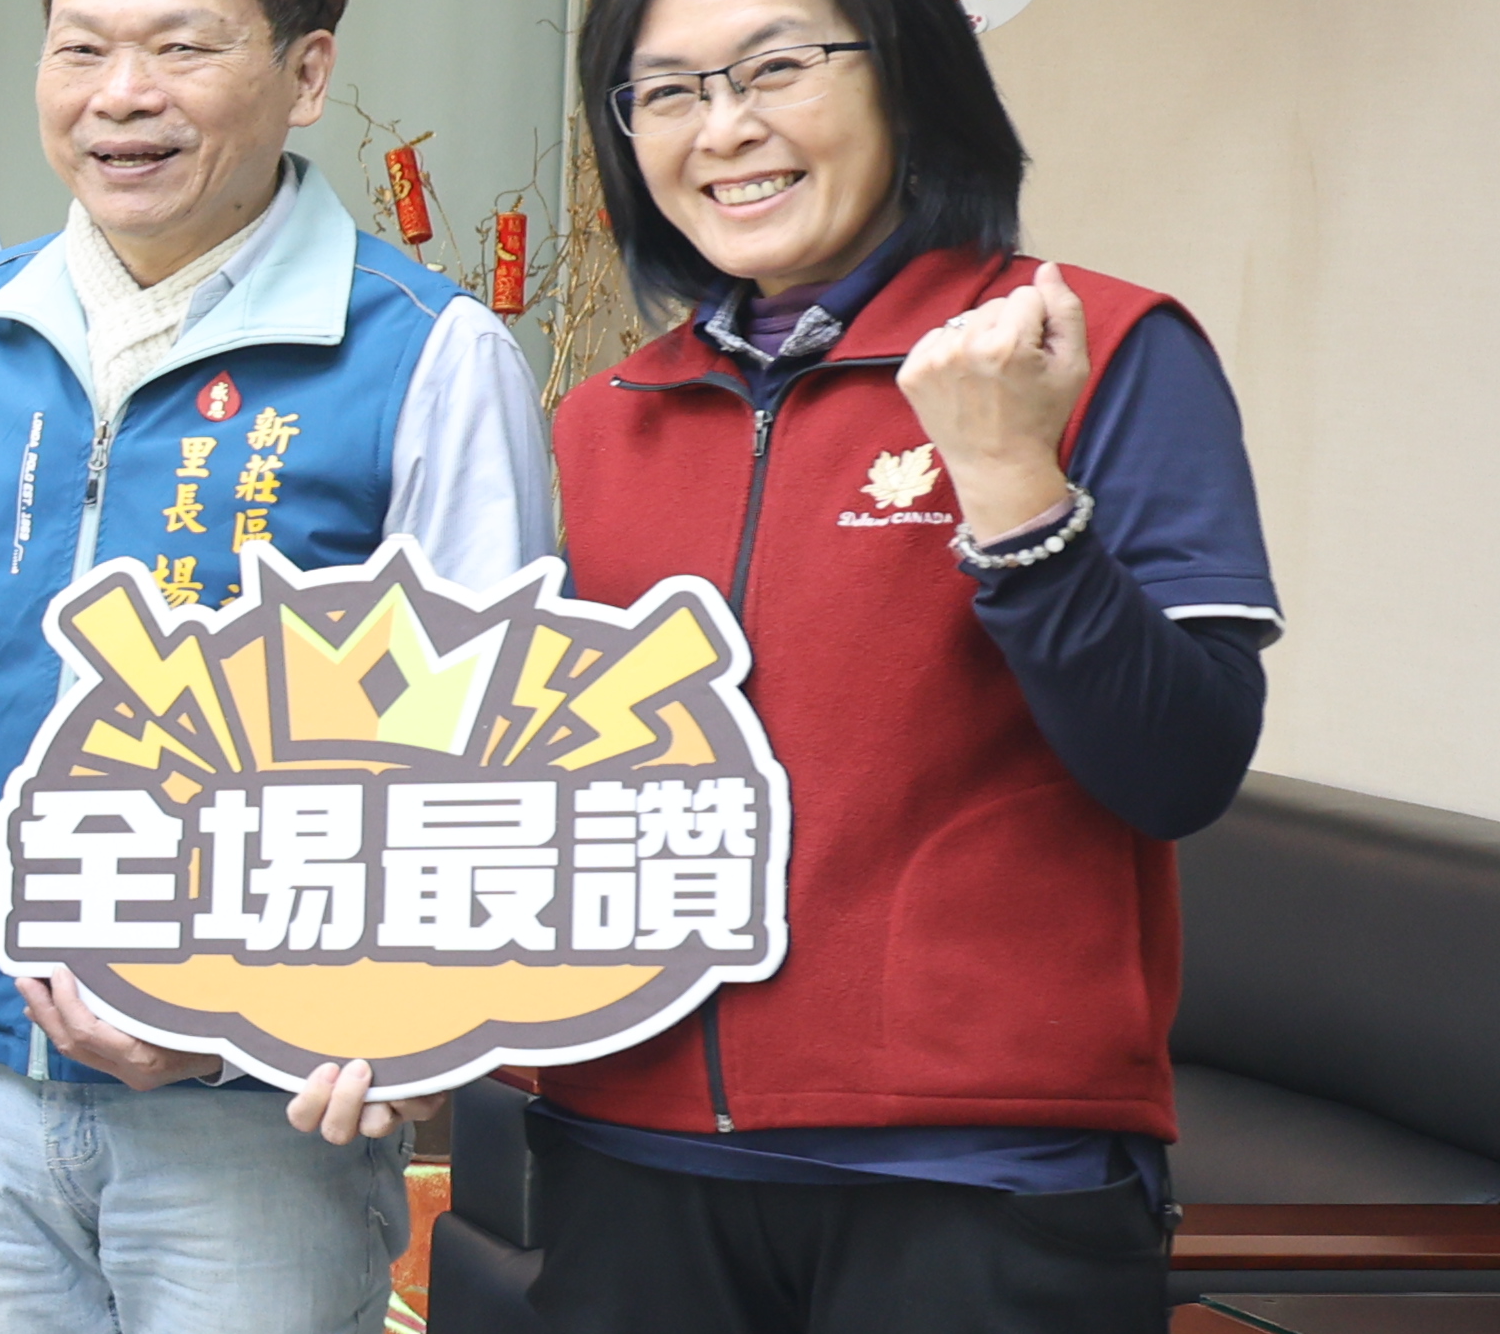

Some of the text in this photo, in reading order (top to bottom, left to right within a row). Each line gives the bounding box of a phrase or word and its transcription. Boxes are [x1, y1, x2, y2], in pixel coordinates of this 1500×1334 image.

[163, 435, 218, 534] 里長
[890, 512, 954, 525] CANADA
[17, 777, 757, 952] 全場最讚
